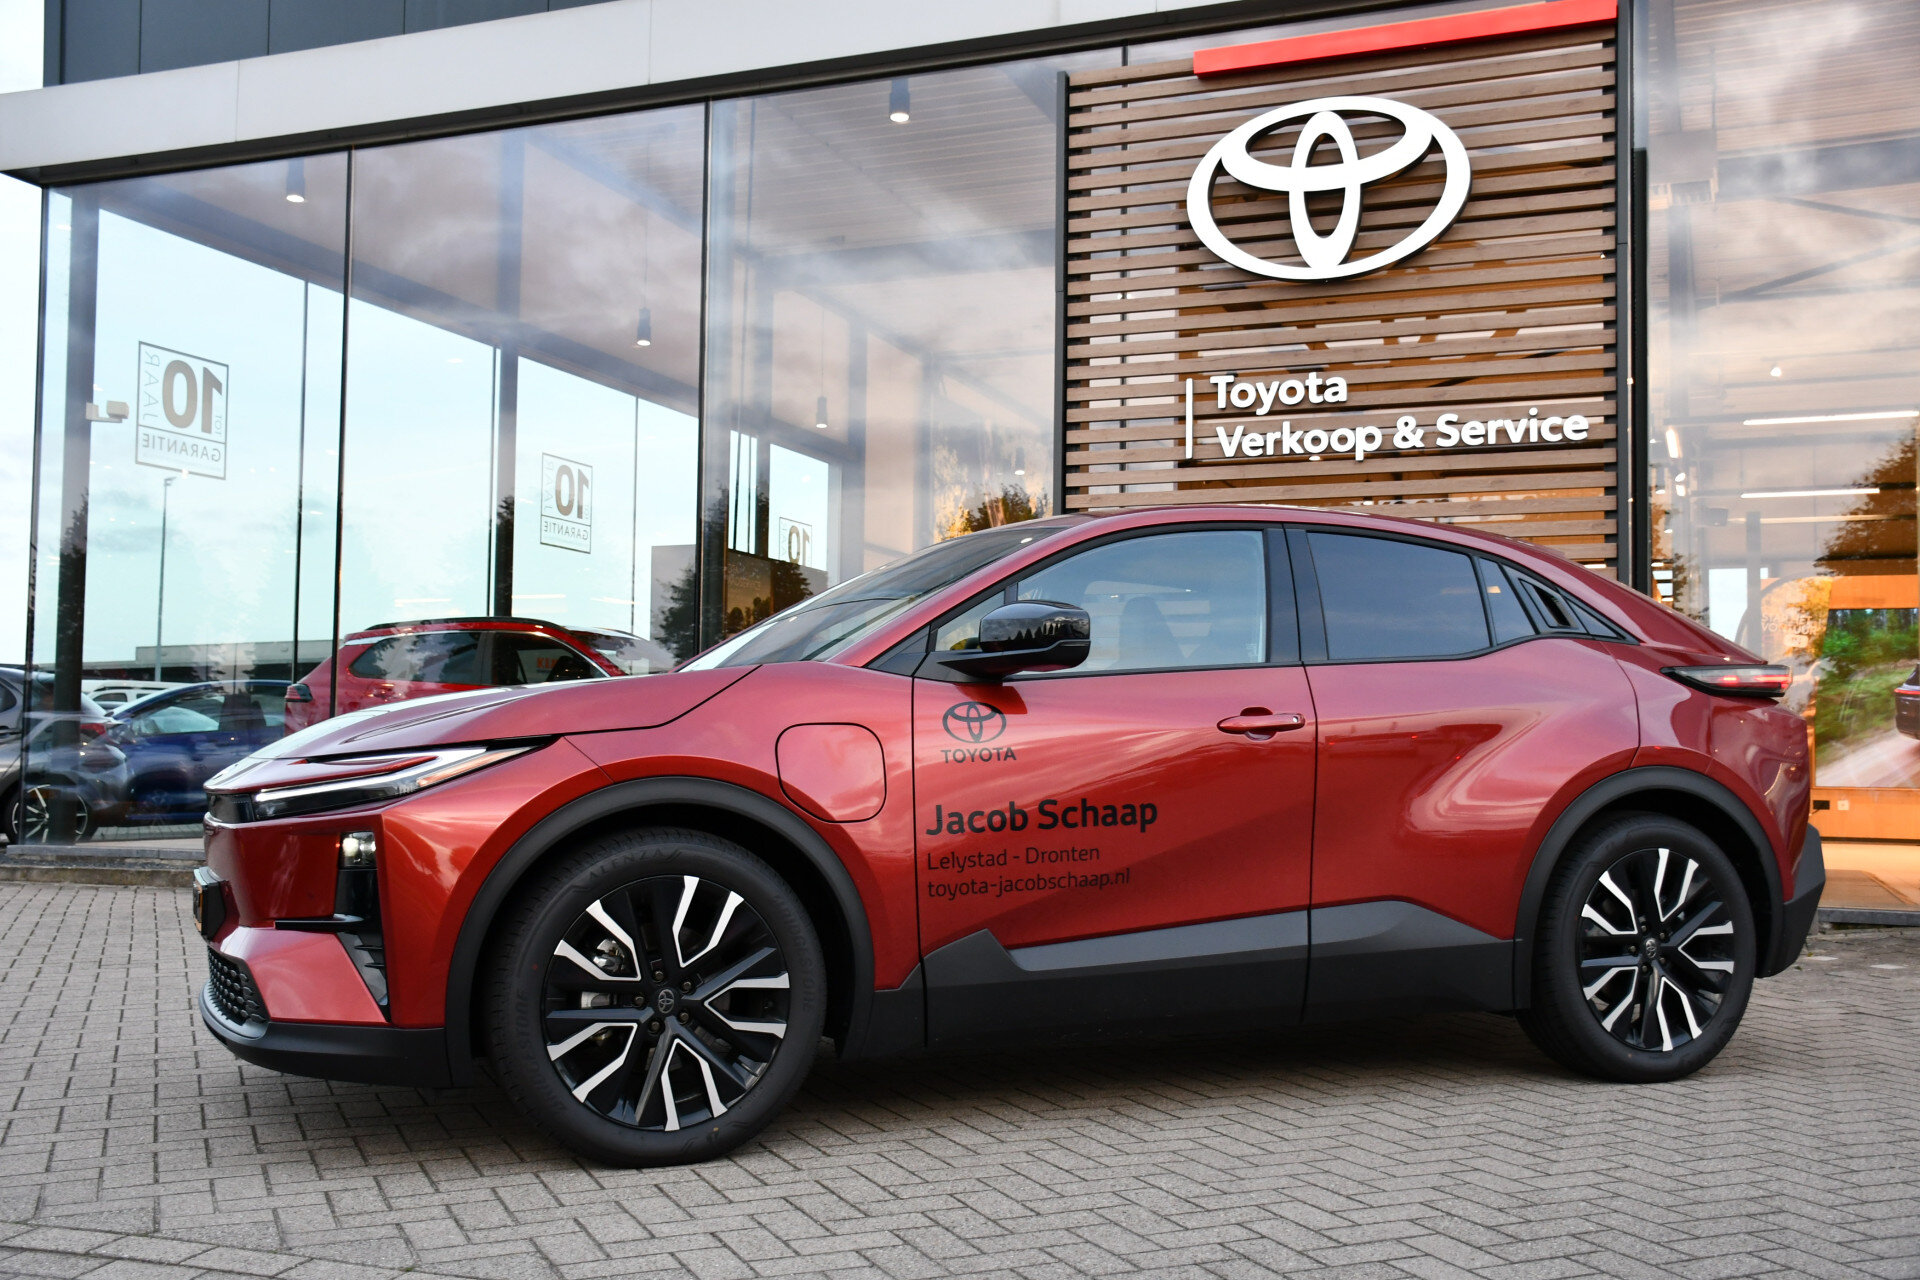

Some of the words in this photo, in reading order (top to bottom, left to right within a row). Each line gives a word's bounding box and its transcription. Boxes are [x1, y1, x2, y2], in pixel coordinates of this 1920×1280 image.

[1209, 371, 1348, 416] Toyota
[1215, 420, 1383, 461] Verkoop
[1392, 415, 1426, 450] &
[1435, 407, 1589, 448] Service
[940, 746, 1017, 764] TOYOTA
[925, 801, 1029, 836] Jacob
[1037, 798, 1158, 833] Schaap
[927, 849, 1008, 874] Lelystad
[1025, 846, 1100, 865] Dronten
[928, 867, 1130, 901] toyota-jacobschaap.nl
